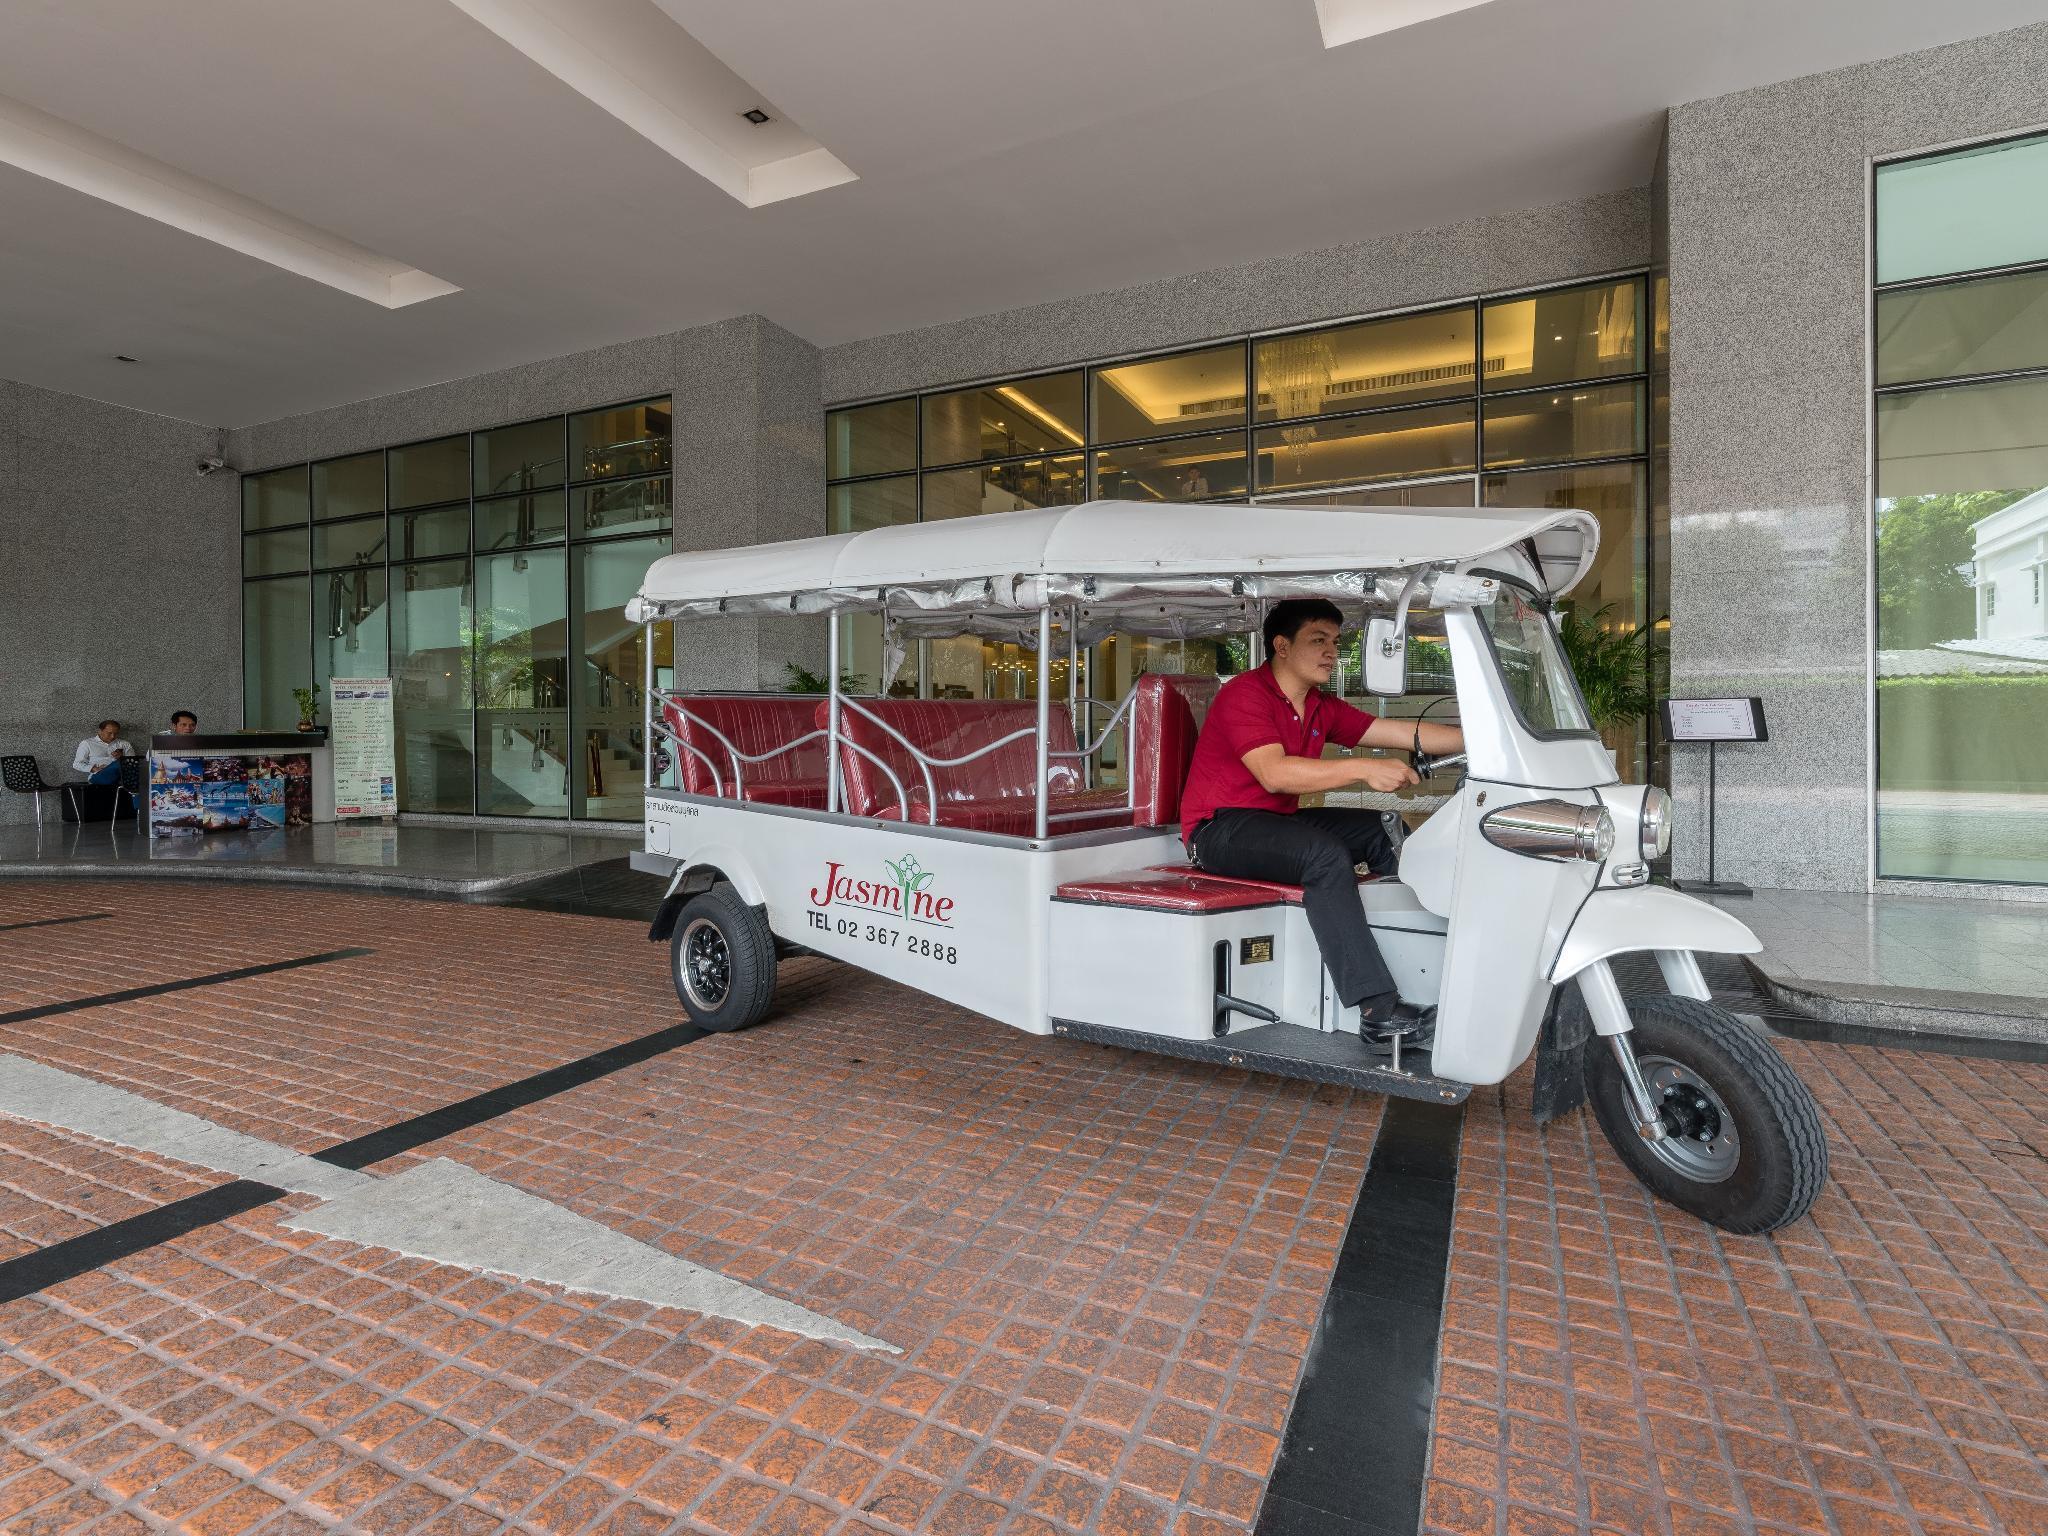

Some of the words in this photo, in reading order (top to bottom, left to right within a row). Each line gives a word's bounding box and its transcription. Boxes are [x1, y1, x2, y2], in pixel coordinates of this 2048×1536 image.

[810, 861, 954, 922] Jasmine
[806, 910, 831, 932] TEL
[837, 919, 858, 938] 02
[866, 925, 900, 947] 367
[907, 935, 957, 965] 2888
